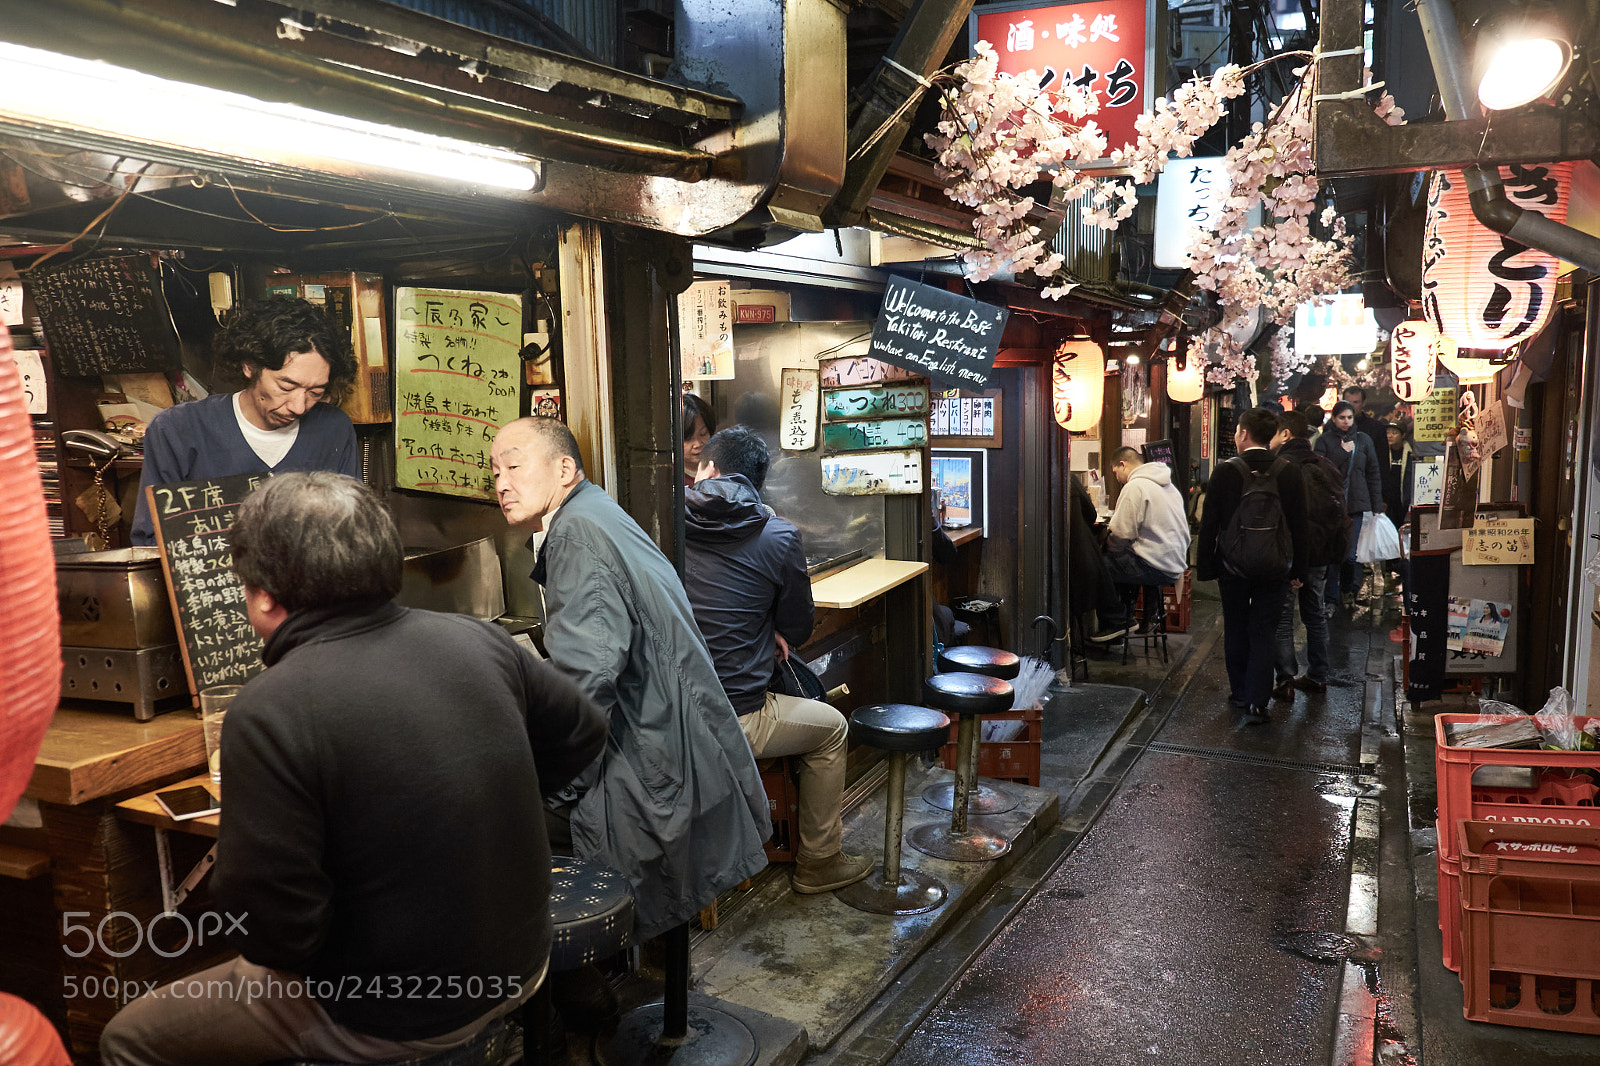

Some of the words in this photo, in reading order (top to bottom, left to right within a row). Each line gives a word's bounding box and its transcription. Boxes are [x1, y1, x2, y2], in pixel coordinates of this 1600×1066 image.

[1006, 12, 1121, 53] 酒・味処
[717, 285, 729, 342] お飲みもの
[884, 283, 938, 322] Welcome
[935, 309, 947, 324] to
[945, 310, 961, 326] the
[959, 309, 993, 336] Best
[417, 354, 484, 378] つくね
[905, 351, 919, 362] an
[917, 349, 957, 376] English
[1393, 327, 1416, 399] やきとり
[848, 391, 897, 411] つくね
[950, 400, 959, 425] レバー
[1425, 423, 1444, 431] 650
[1510, 841, 1578, 854] サッポロビール
